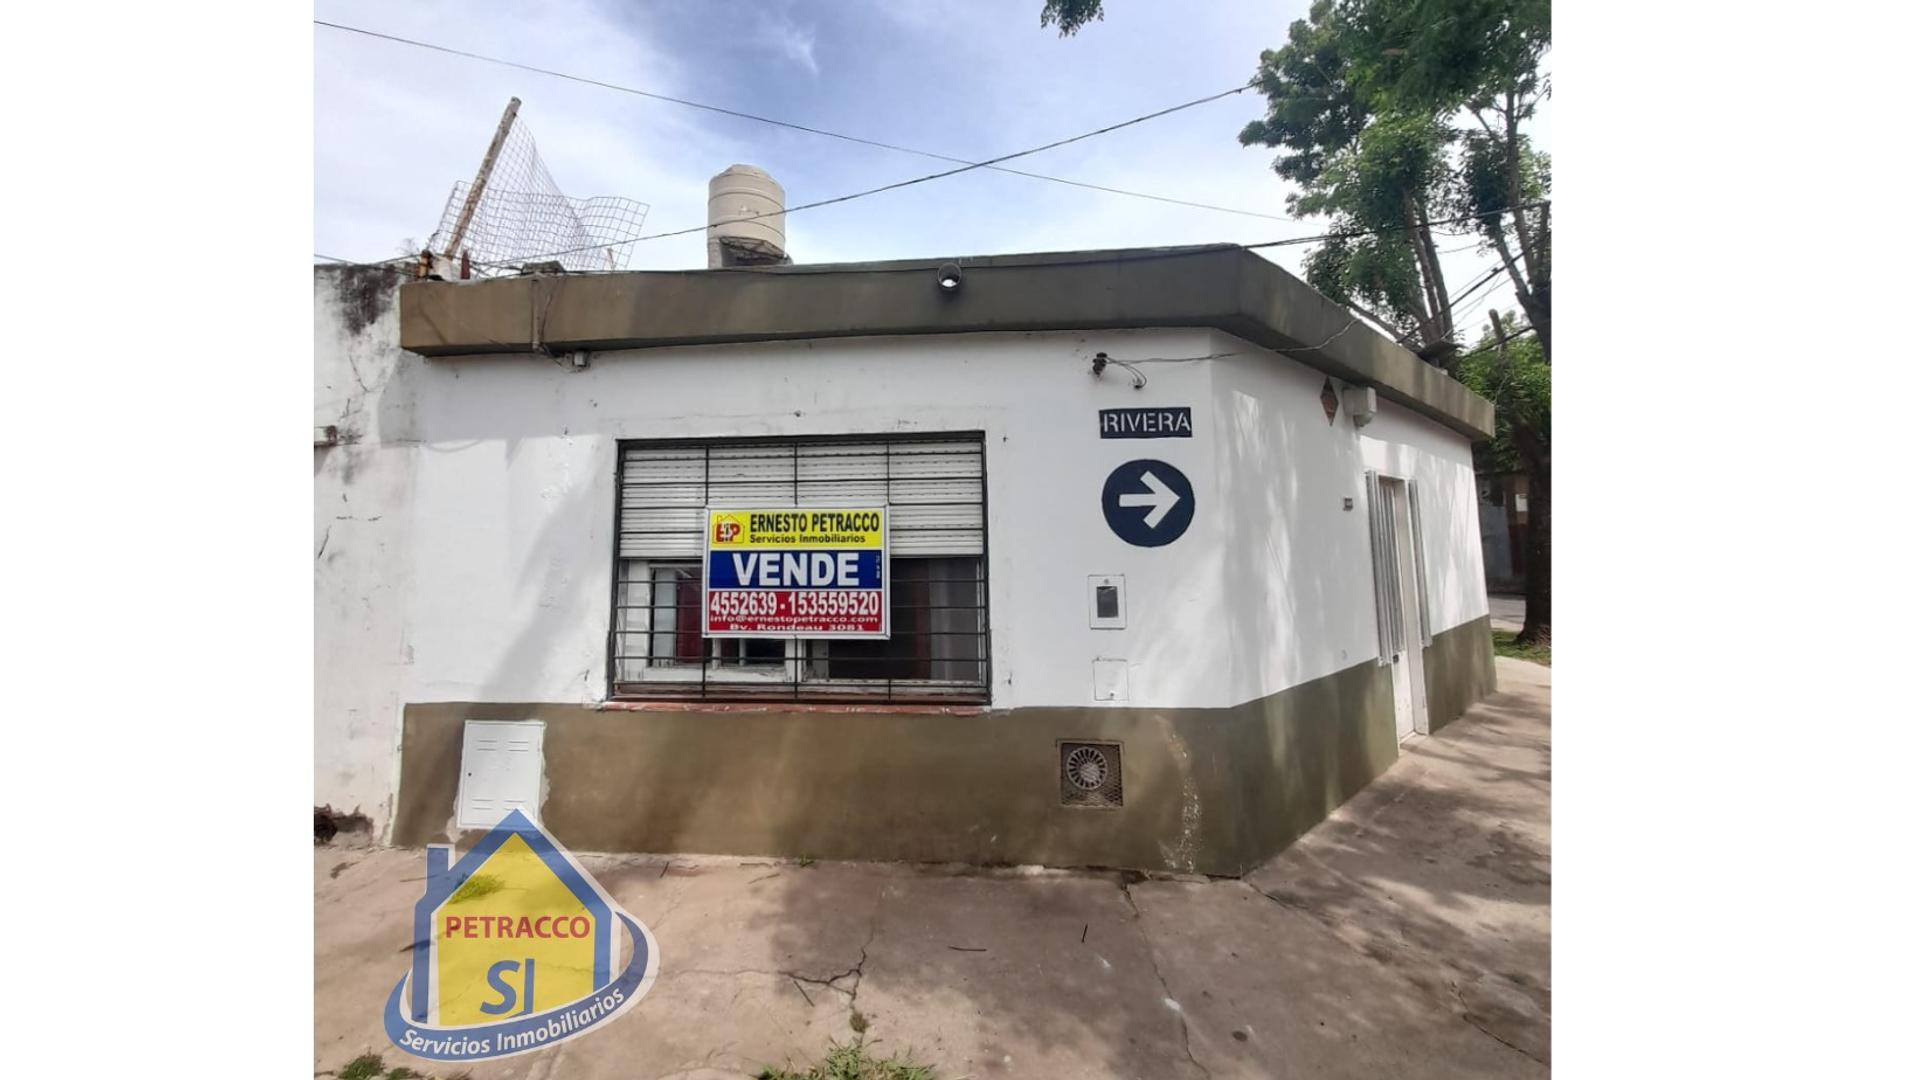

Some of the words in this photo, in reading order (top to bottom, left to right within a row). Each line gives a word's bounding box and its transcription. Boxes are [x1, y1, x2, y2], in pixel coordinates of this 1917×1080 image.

[1103, 412, 1191, 433] RIVERA
[750, 513, 807, 533] ERNESTO
[812, 512, 880, 533] PETRACCO
[750, 533, 796, 544] Servicios
[799, 533, 866, 544] Inmobiliarios
[732, 552, 860, 587] VENDE
[710, 592, 777, 616] 4552639
[788, 591, 879, 616] 153559520
[710, 615, 878, 624] info@ernestopetracco.com
[729, 623, 752, 631] Bv.
[756, 623, 823, 632] Rondeau
[829, 623, 864, 631] 3081
